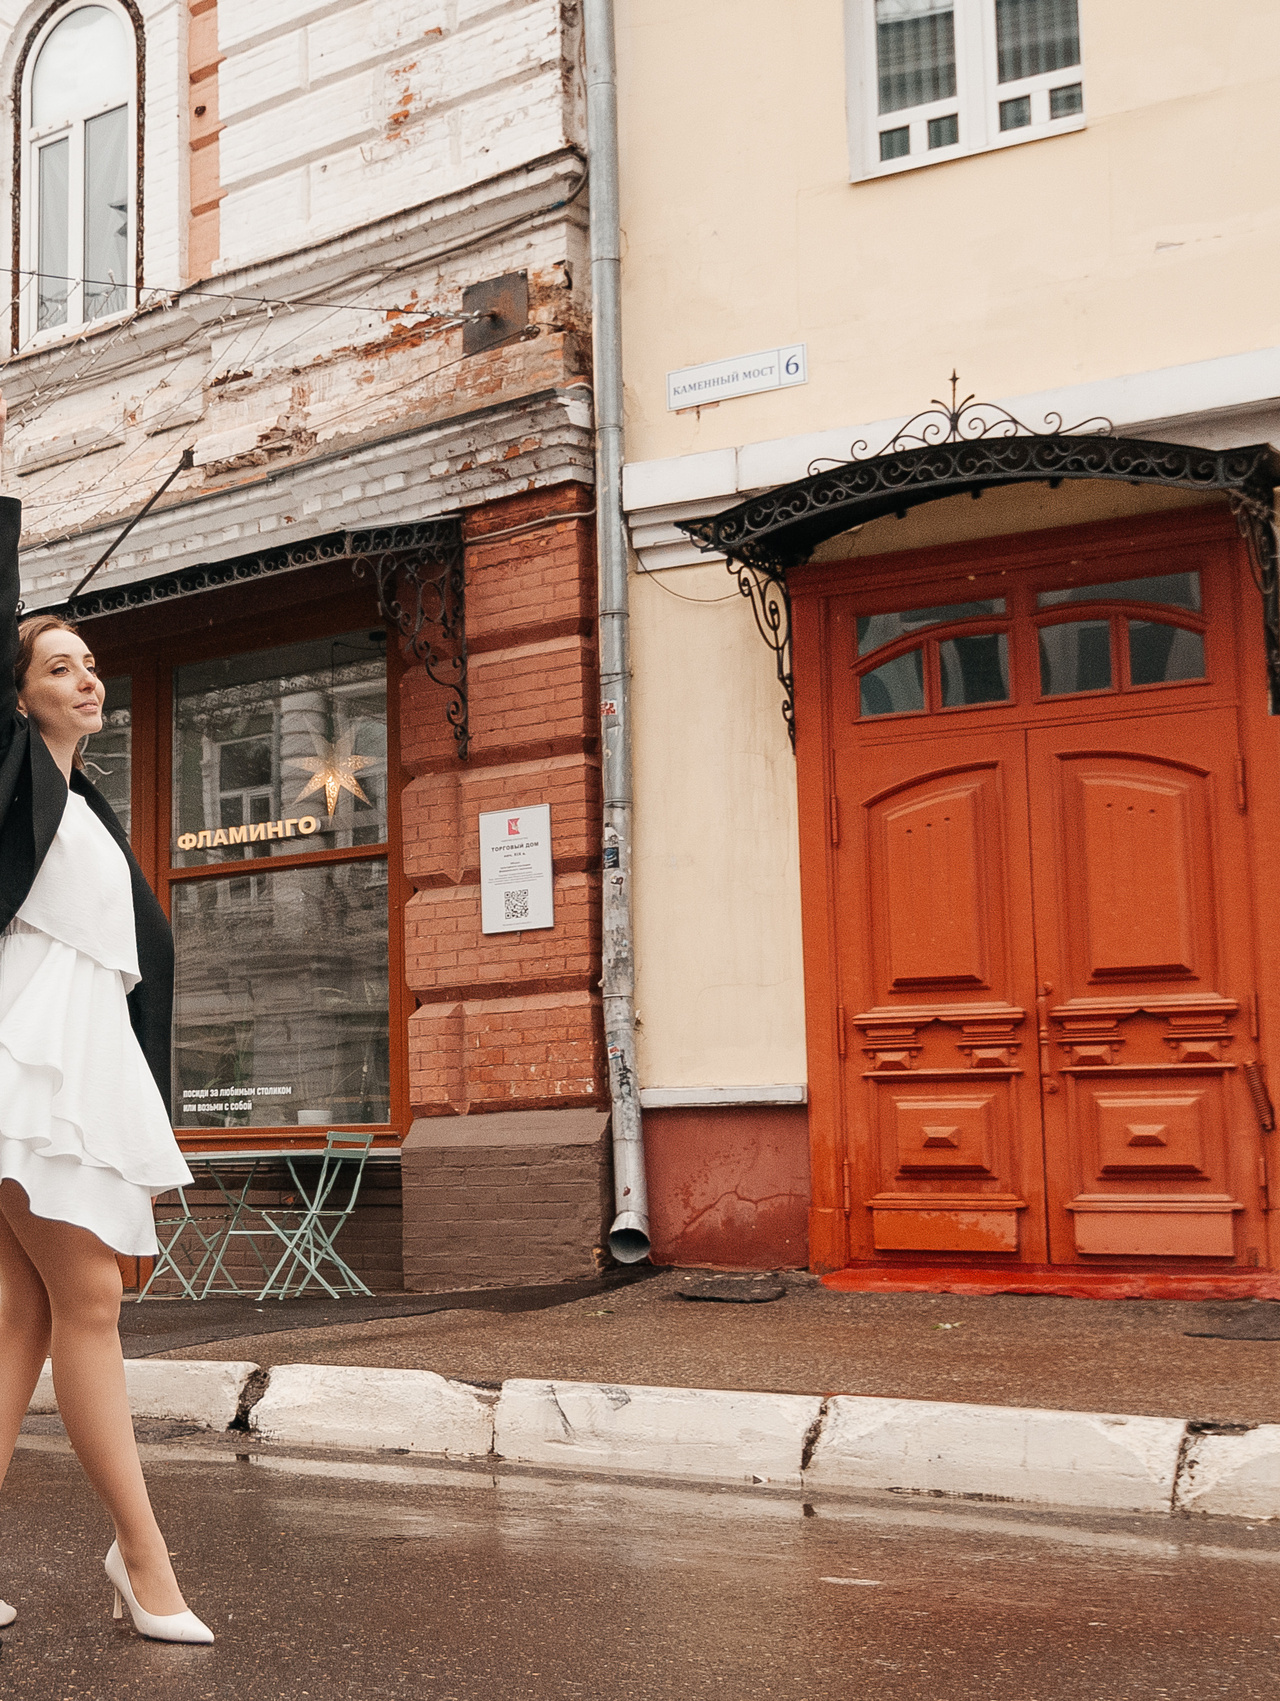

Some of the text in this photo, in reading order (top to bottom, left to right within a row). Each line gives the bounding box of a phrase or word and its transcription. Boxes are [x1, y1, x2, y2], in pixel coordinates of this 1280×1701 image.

[673, 354, 799, 396] КАМЕННЫЙ МОСТ 6
[177, 815, 318, 850] ФЛАМИНГО
[491, 841, 539, 852] ТОРГОВЫЙ ДОМ
[183, 1089, 209, 1099] посиди
[219, 1086, 255, 1097] любимым
[256, 1086, 292, 1095] столиком
[183, 1100, 252, 1112] или возьми с собой
